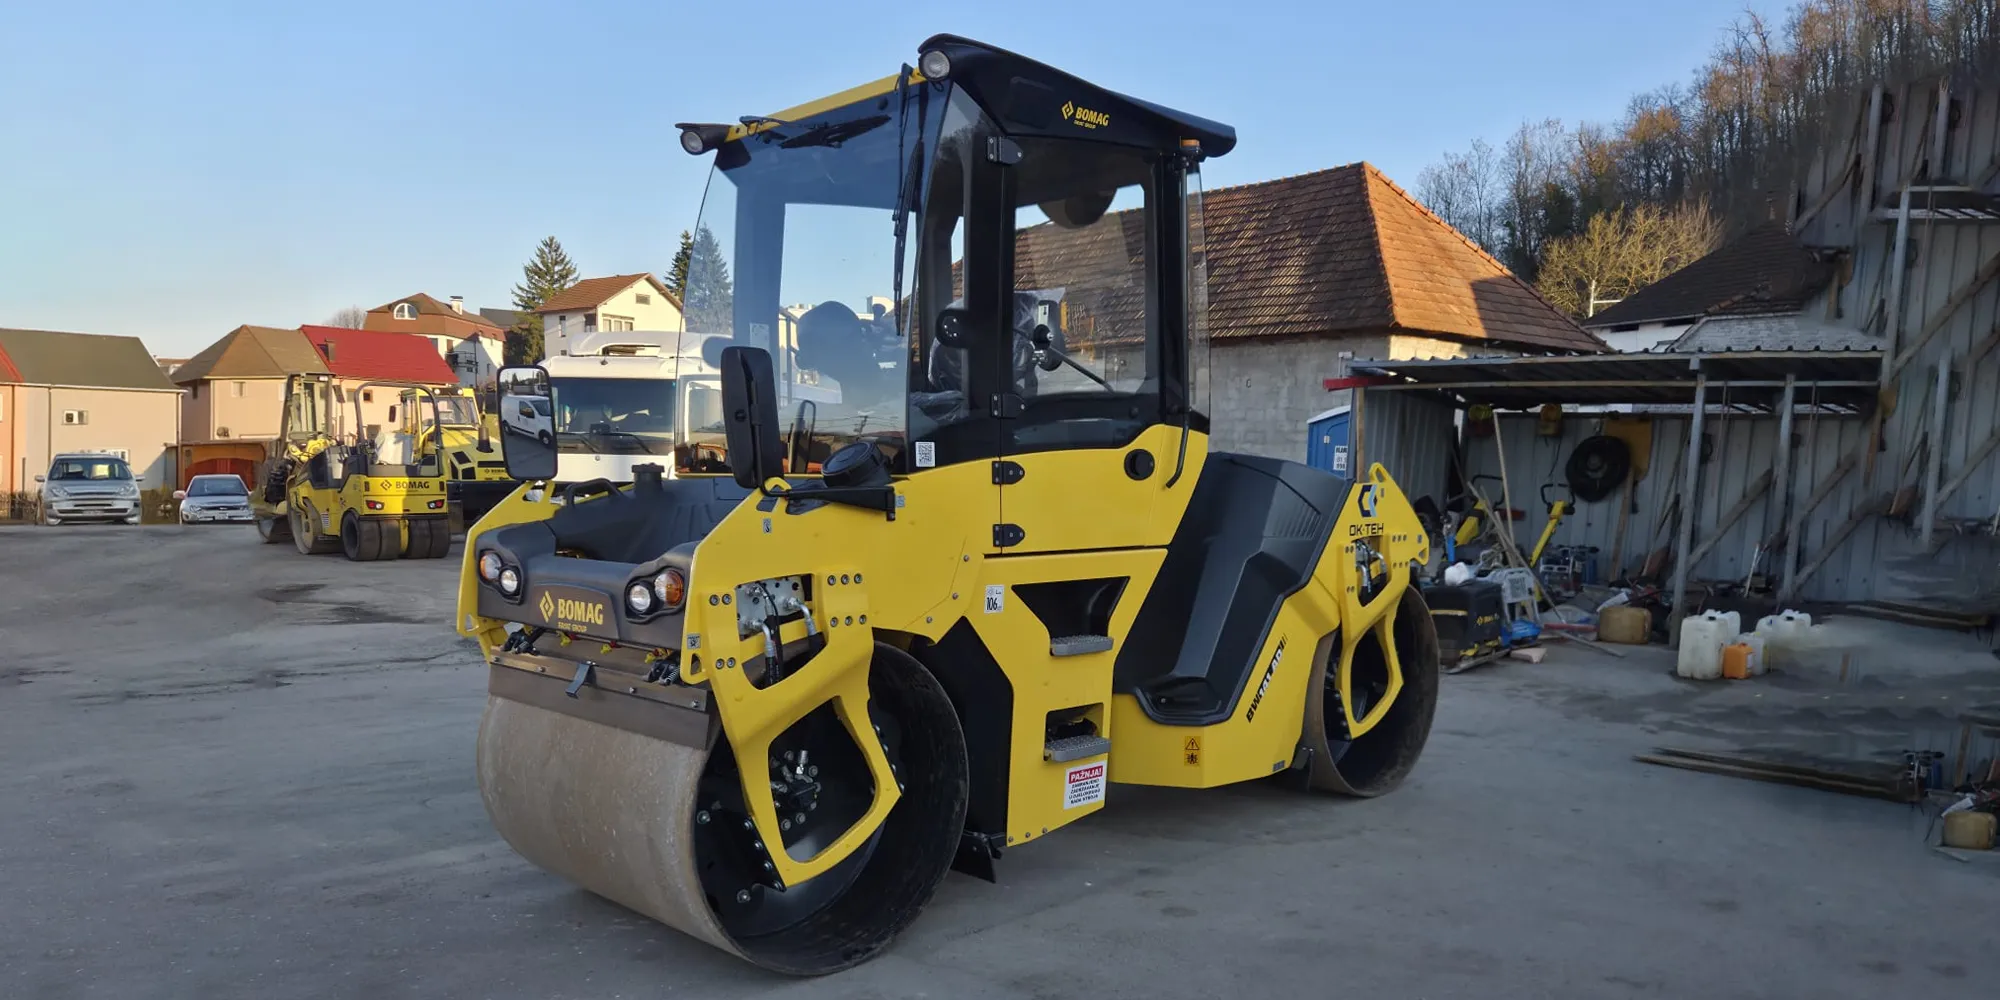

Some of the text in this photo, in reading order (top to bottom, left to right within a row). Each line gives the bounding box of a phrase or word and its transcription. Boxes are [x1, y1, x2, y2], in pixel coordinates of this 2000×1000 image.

[1075, 106, 1110, 127] BOMAG
[395, 481, 430, 489] BOMAG
[986, 597, 998, 610] 106
[558, 598, 604, 625] BOMAG
[1070, 767, 1103, 782] PAŽNJA!
